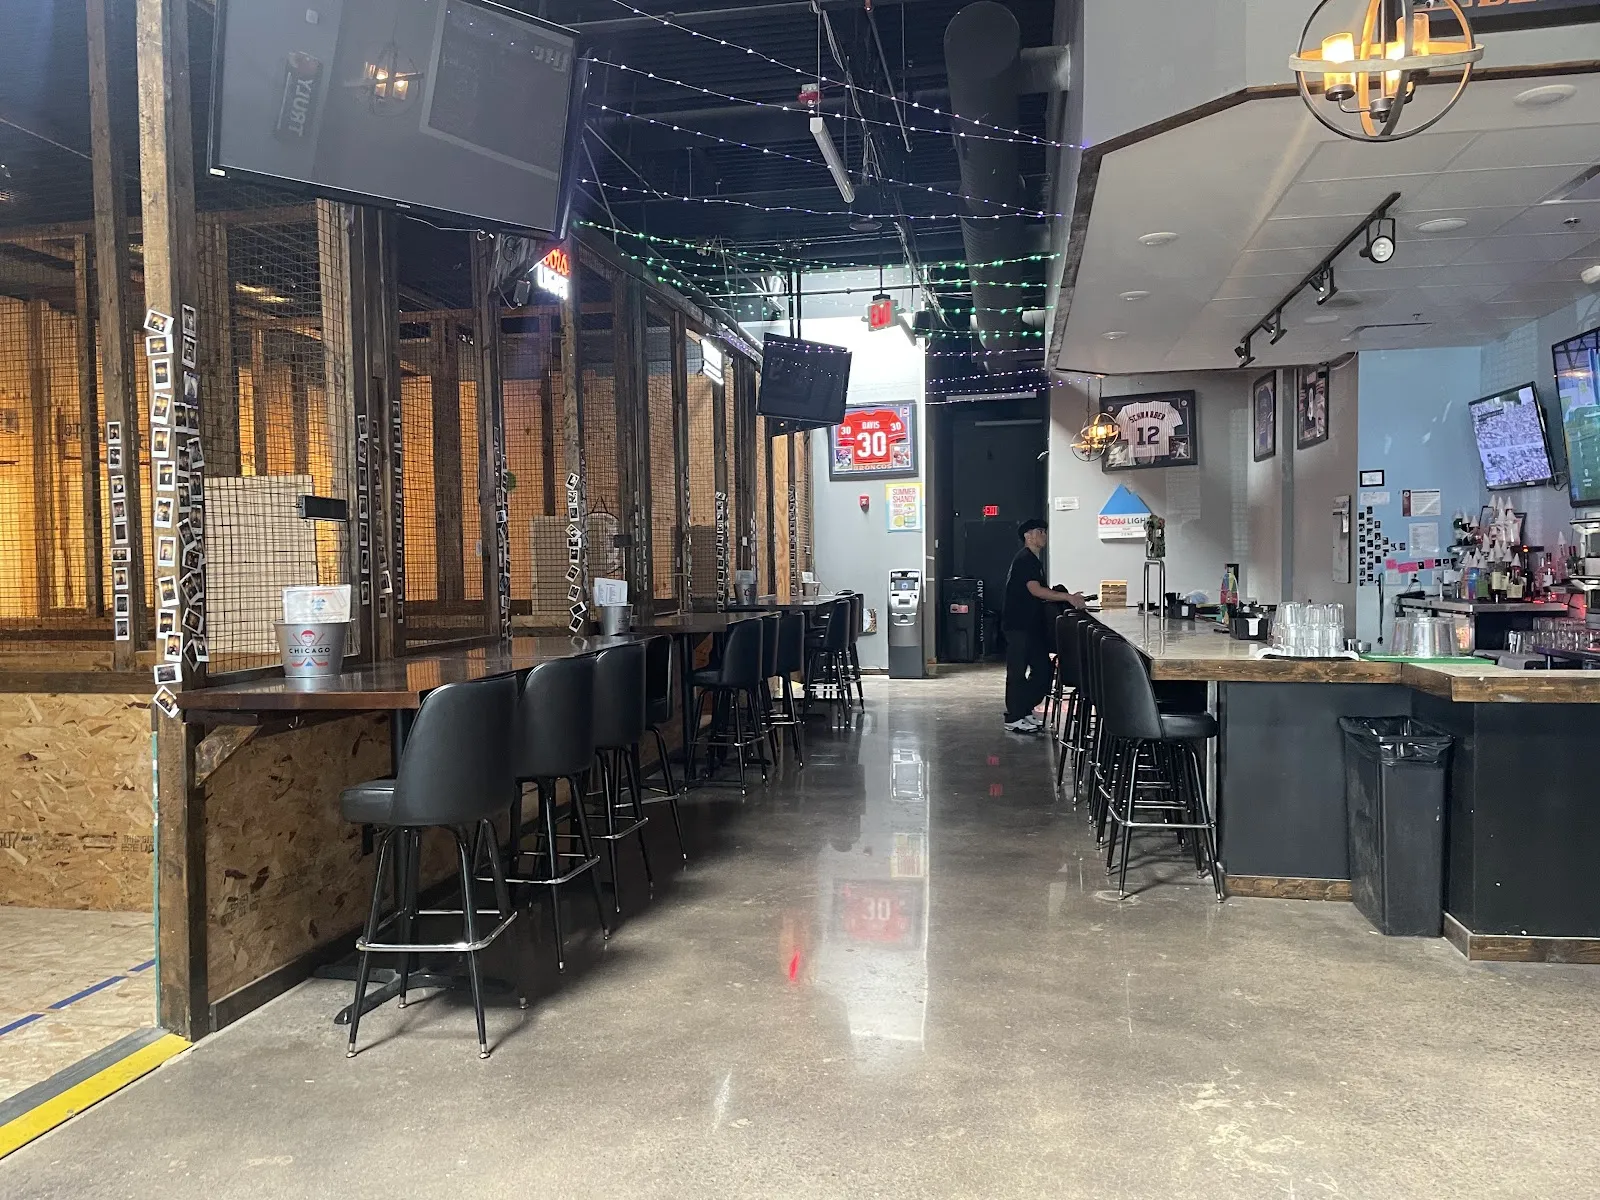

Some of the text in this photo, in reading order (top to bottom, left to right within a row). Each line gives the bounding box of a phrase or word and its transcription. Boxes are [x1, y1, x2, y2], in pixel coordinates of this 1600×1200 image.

[862, 421, 880, 430] DAVIS
[889, 422, 902, 432] 30
[840, 426, 852, 435] 30
[1137, 426, 1160, 446] 12
[856, 431, 887, 458] 30
[892, 488, 916, 496] SUMMER
